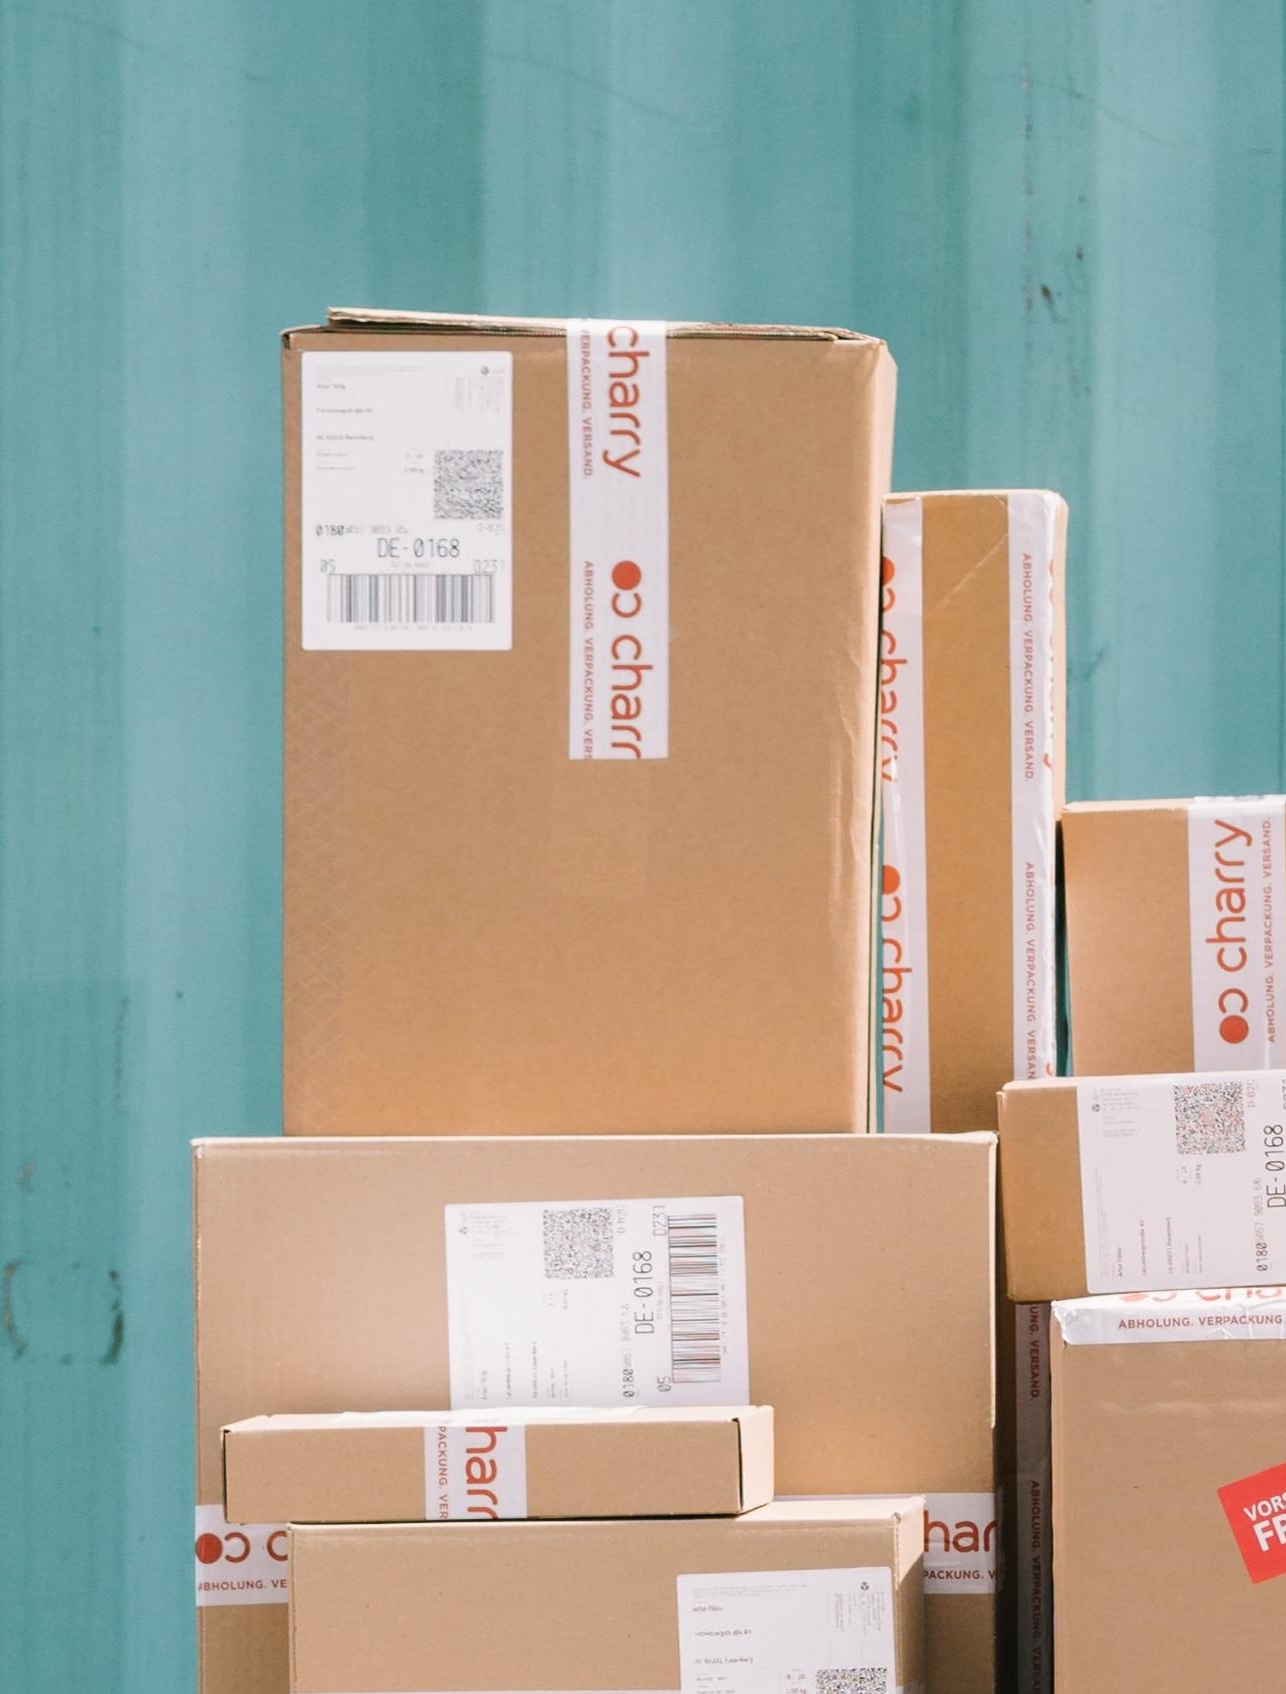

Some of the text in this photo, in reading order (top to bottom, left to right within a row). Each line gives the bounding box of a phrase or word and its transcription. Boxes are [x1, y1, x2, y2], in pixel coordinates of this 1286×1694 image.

[603, 326, 650, 478] charry
[376, 538, 461, 558] DE-0168
[582, 560, 594, 724] ABHOLUNG. VERPACKUNG.
[1022, 553, 1035, 783] ABHOLUNG. VERPACKUNG. VERSAND.
[611, 634, 653, 760] charr
[1025, 862, 1036, 935] ABHOLUNG.
[1205, 818, 1253, 973] charry
[1262, 816, 1277, 1044] ABHOLUNG. VERPACKUNG. VERSAND.
[1025, 938, 1036, 1024] VERPACKUNG.
[1264, 1124, 1286, 1208] DE-0168
[632, 1250, 654, 1334] DE-0168
[1118, 1317, 1195, 1329] ABHOLUNG.
[1198, 1314, 1286, 1327] VERPACKUNG.
